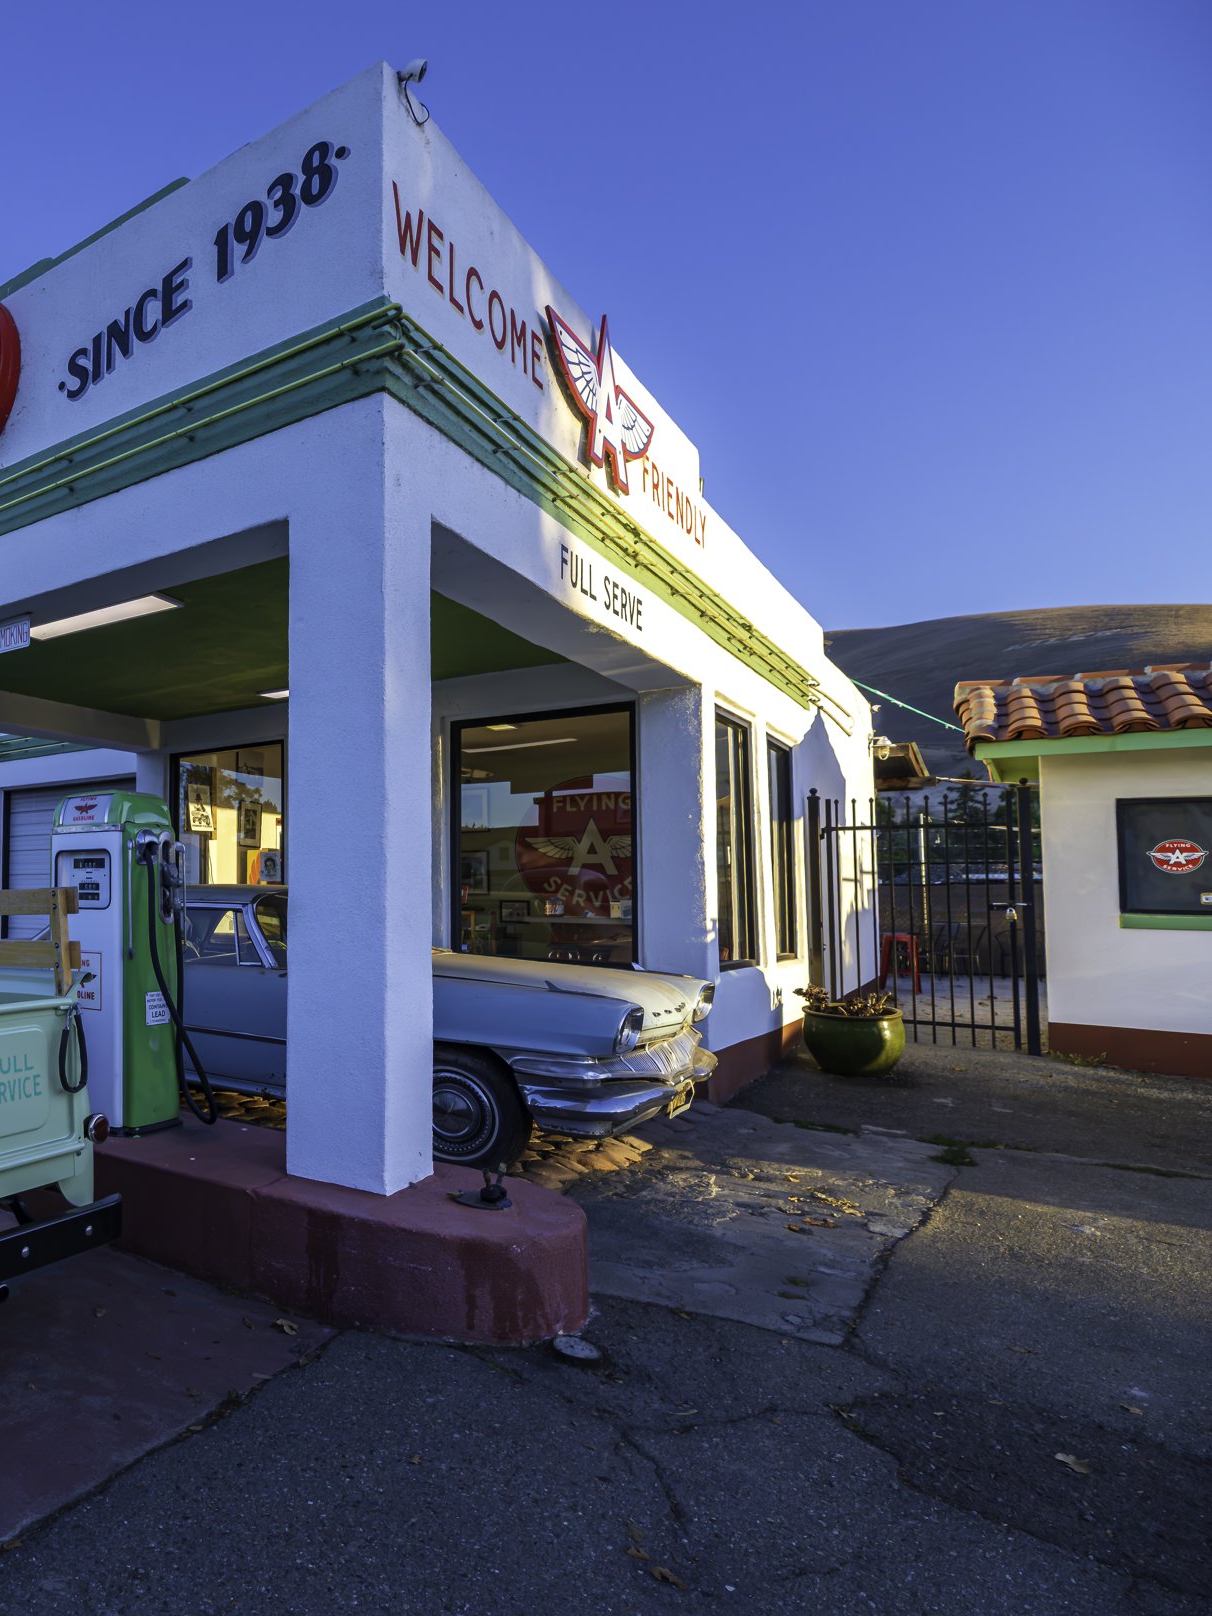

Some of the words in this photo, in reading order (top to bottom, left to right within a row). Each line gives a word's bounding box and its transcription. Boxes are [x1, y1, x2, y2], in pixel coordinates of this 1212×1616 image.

[392, 180, 544, 391] WELCOME
[643, 454, 706, 549] FRIENDLY
[560, 543, 597, 602] FULL
[604, 574, 644, 632] SERVE
[552, 793, 631, 812] FLYING
[568, 817, 619, 875] A
[1169, 848, 1187, 864] A
[151, 1010, 166, 1018] LEAD
